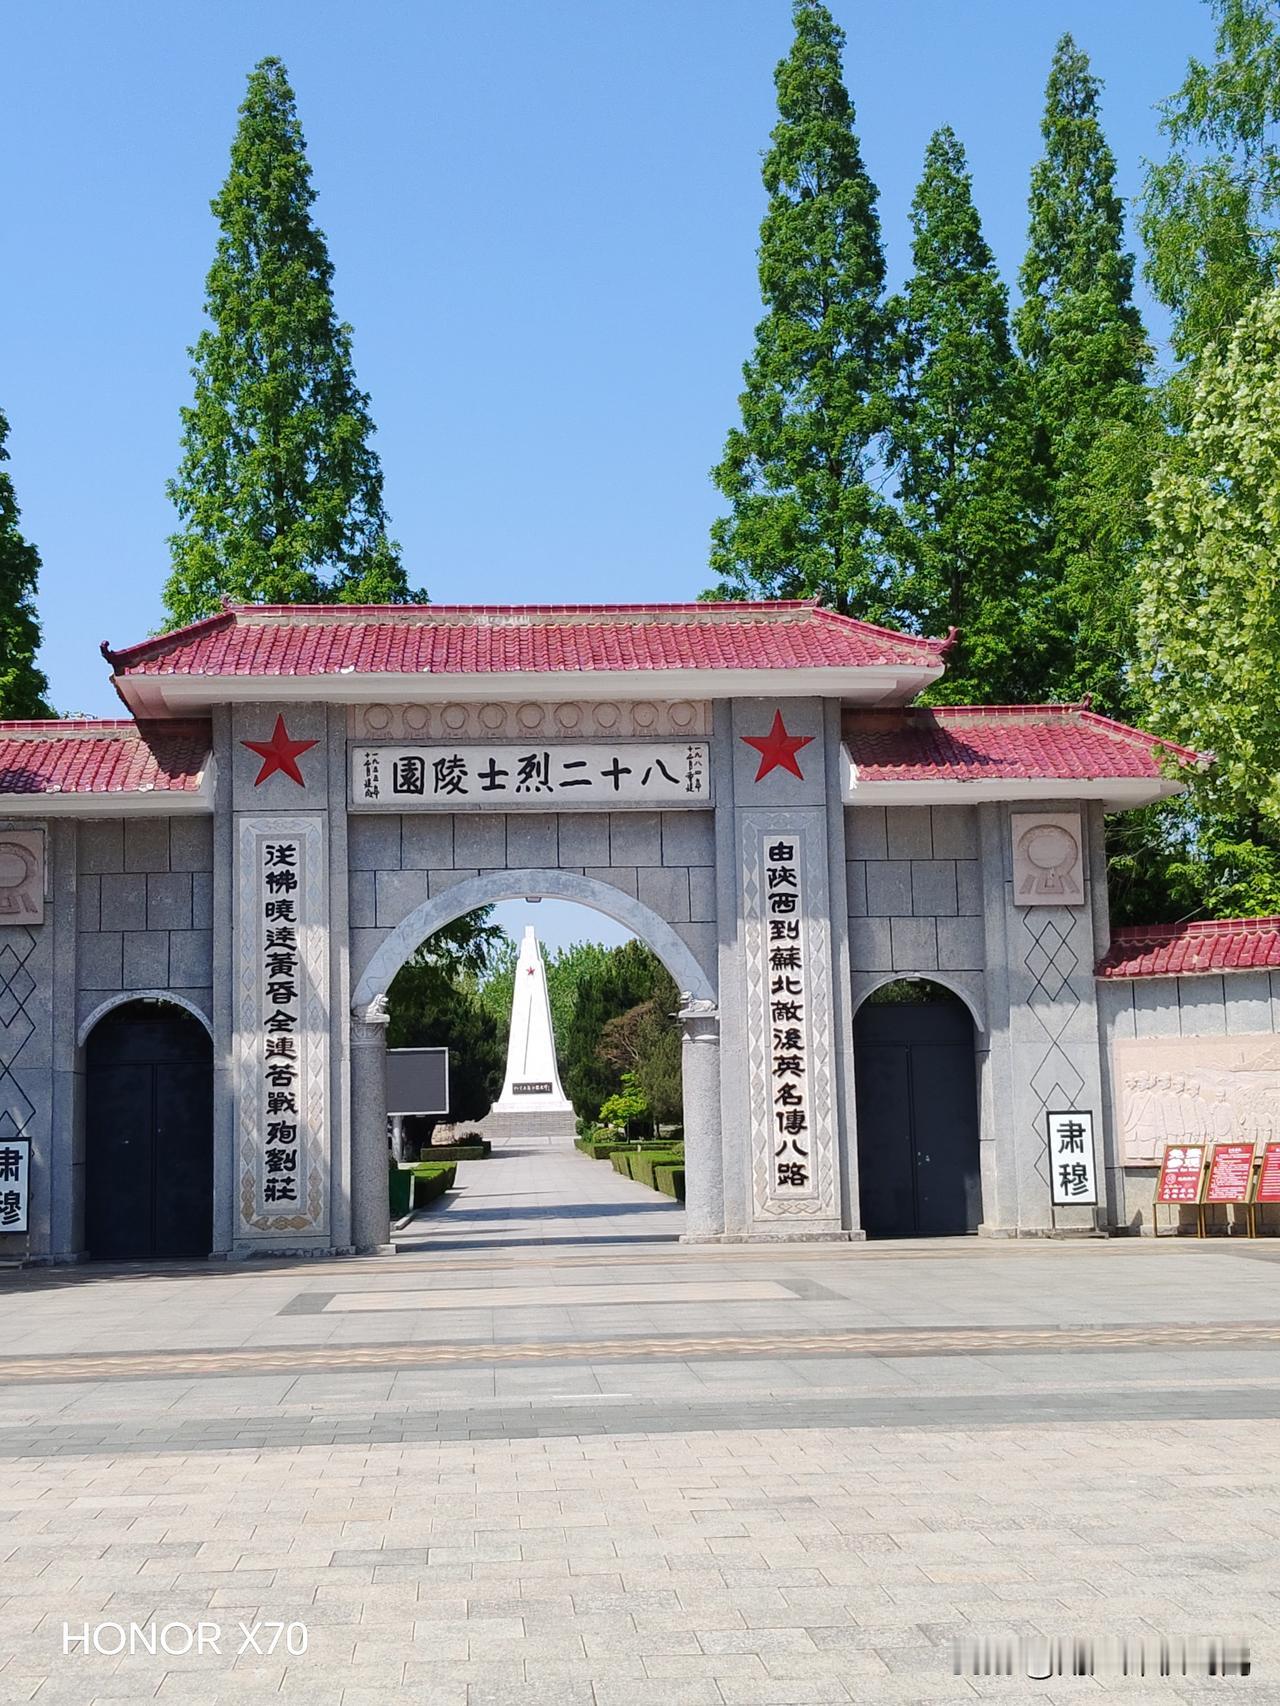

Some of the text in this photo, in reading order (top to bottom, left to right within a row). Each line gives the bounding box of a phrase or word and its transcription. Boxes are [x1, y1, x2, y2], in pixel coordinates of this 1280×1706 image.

[392, 751, 681, 796] 八十二烈士陵園
[1056, 1119, 1089, 1197] 肃穆
